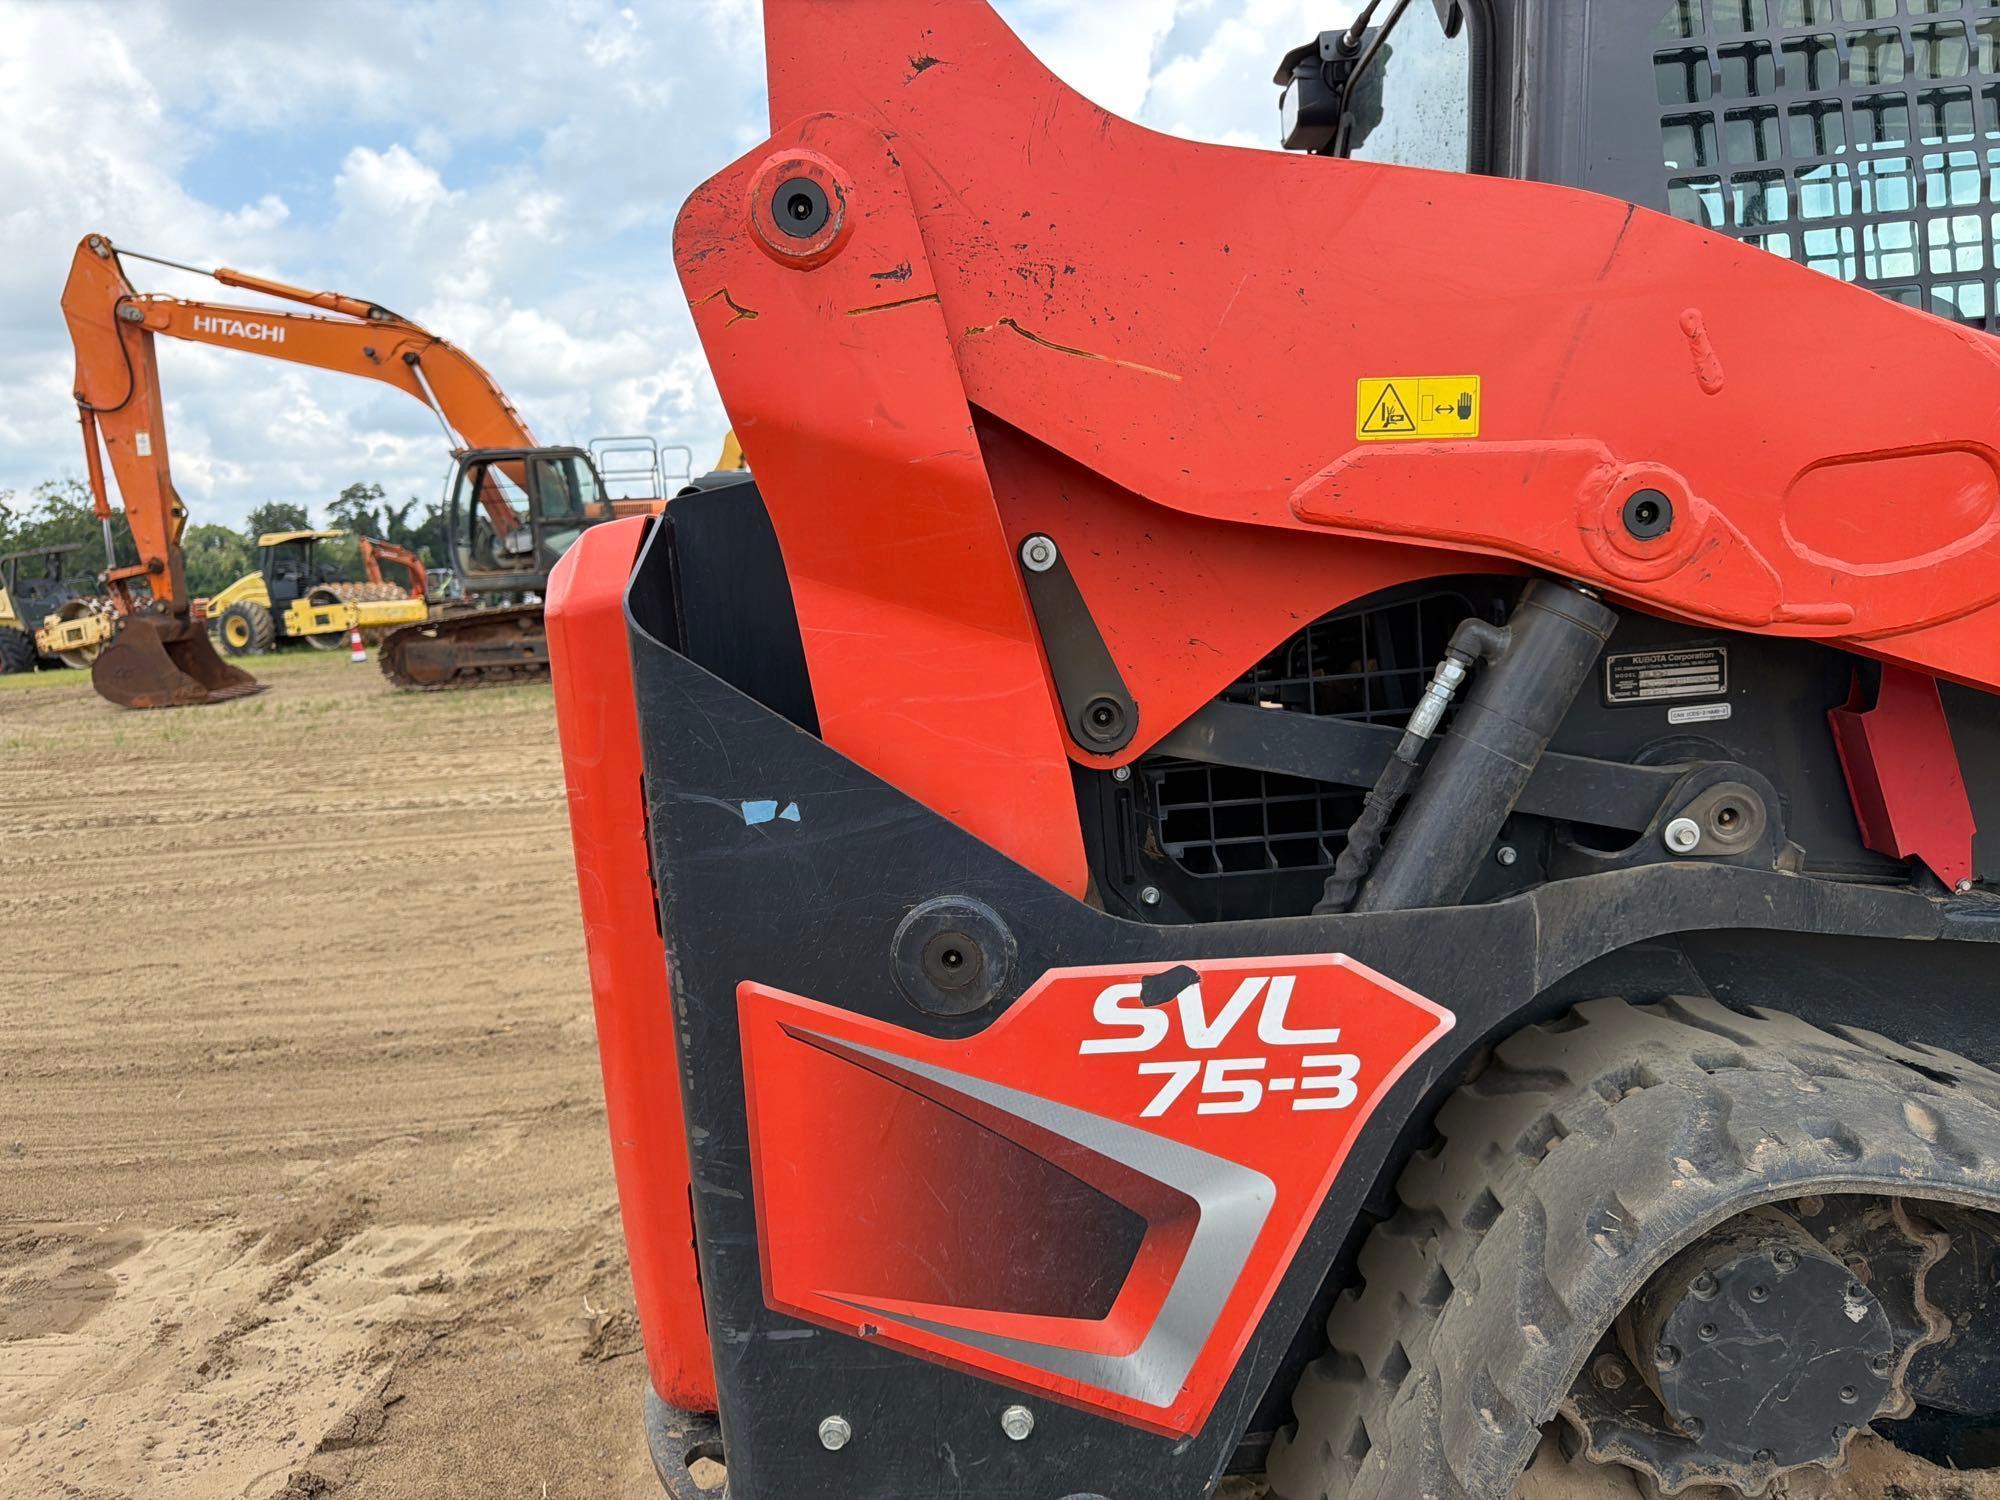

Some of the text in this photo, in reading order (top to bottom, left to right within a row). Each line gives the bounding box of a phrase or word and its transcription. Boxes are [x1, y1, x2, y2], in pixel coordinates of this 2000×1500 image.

[193, 315, 286, 343] HITACHI
[1632, 652, 1714, 664] KUBOTA Corporation
[1078, 975, 1341, 1055] SVL
[1138, 1053, 1361, 1118] 75-3
